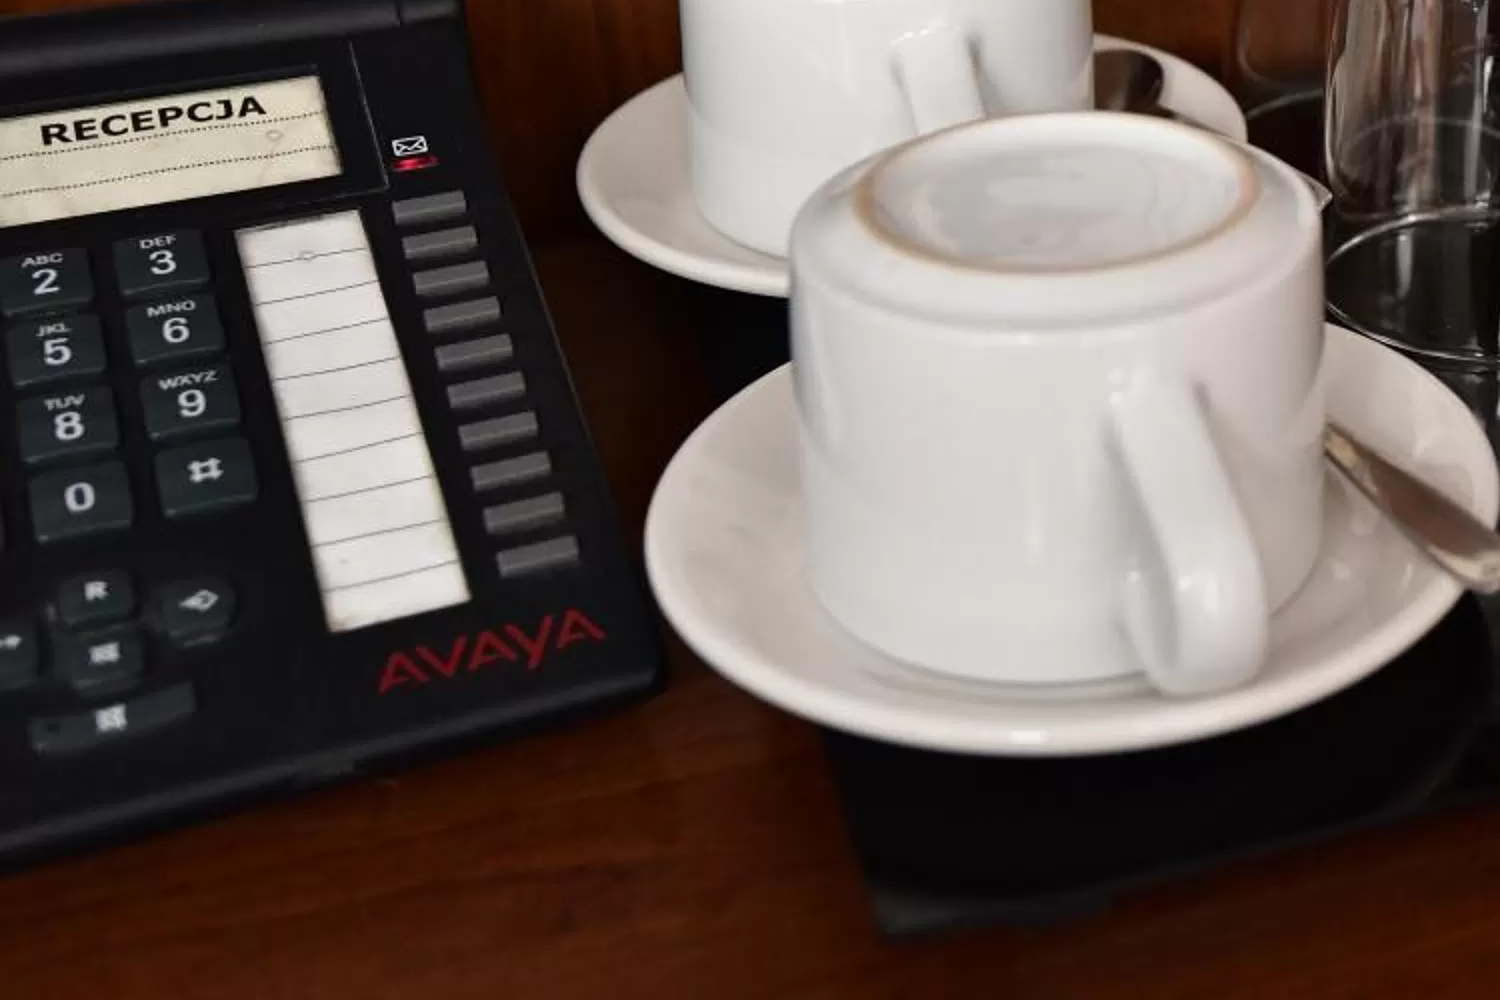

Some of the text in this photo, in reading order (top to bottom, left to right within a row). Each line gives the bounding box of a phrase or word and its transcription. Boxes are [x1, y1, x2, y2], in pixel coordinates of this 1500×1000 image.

[40, 96, 267, 146] RECEPCJA
[139, 234, 177, 249] DEF
[21, 252, 64, 268] ABC
[149, 250, 177, 275] 3
[32, 268, 61, 296] 2
[146, 299, 197, 318] MNO
[162, 317, 190, 344] 6
[43, 337, 72, 365] 5
[158, 369, 220, 391] WXYZ
[177, 389, 207, 417] 9
[53, 411, 85, 440] 8
[64, 482, 96, 512] 0
[379, 607, 608, 696] AVAYA
